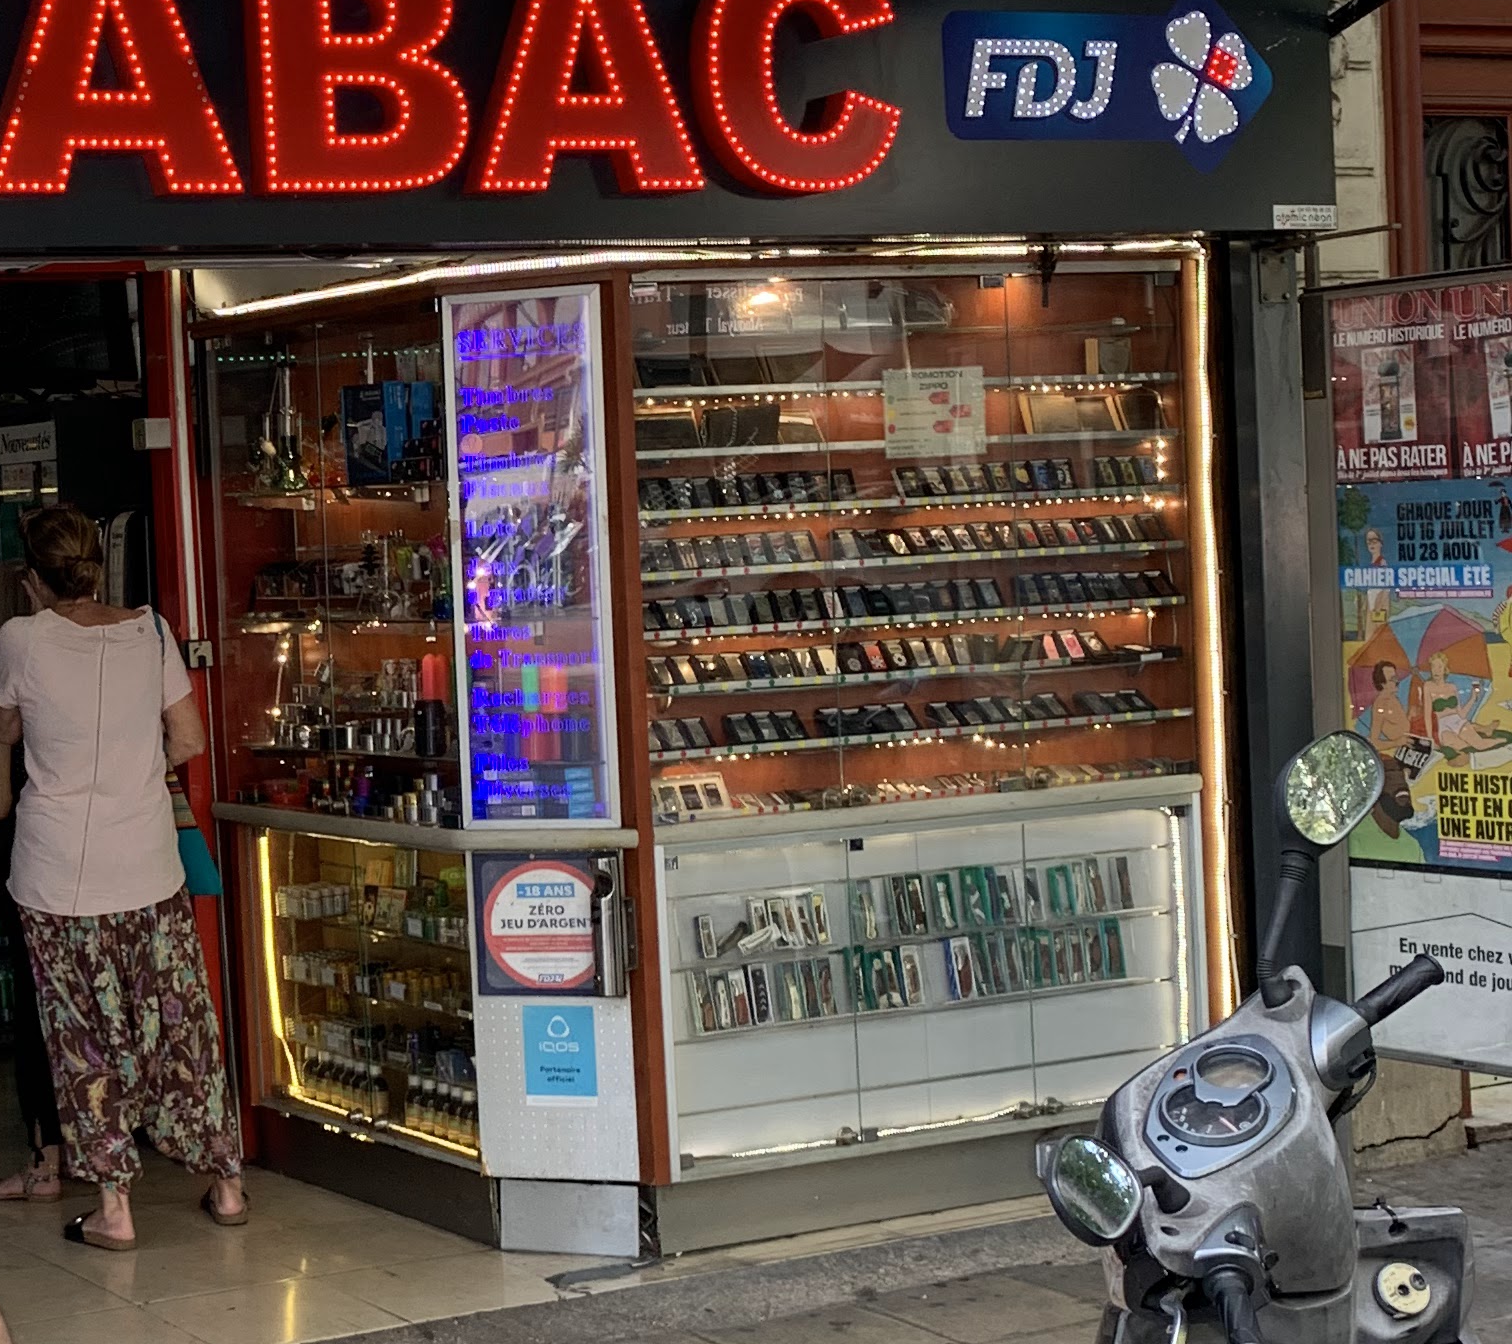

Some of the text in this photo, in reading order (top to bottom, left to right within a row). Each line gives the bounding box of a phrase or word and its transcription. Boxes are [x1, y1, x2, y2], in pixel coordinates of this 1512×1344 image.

[966, 37, 1118, 120] FDJ
[1334, 288, 1445, 331] UNION
[457, 322, 586, 354] SERVICES
[1333, 323, 1445, 348] LE NUMÉRO HISTORIQUE
[1453, 324, 1466, 340] LE
[459, 413, 521, 434] Poste
[1337, 444, 1447, 470] À NE PAS RATER
[1463, 441, 1474, 468] À
[1476, 443, 1499, 467] NE
[1396, 499, 1494, 522] CHAQUE JOUR
[1397, 520, 1495, 541] DU 16 JUILLET
[1398, 542, 1416, 561] AU
[1418, 542, 1438, 561] 28
[1344, 563, 1492, 587] CAHIER SPÉCIAL ÉTÉ
[1438, 771, 1512, 796] UNE HIST
[1439, 794, 1478, 816] PEUT
[1483, 797, 1503, 818] EN
[1440, 817, 1470, 839] UNE
[518, 884, 573, 896] -18 ANS
[528, 902, 565, 916] ZÉRO
[500, 918, 524, 929] JEU
[1399, 937, 1417, 954] En
[1422, 942, 1463, 960] vente
[1468, 945, 1504, 964] chez
[1469, 971, 1487, 987] de
[538, 1041, 580, 1054] IQOS
